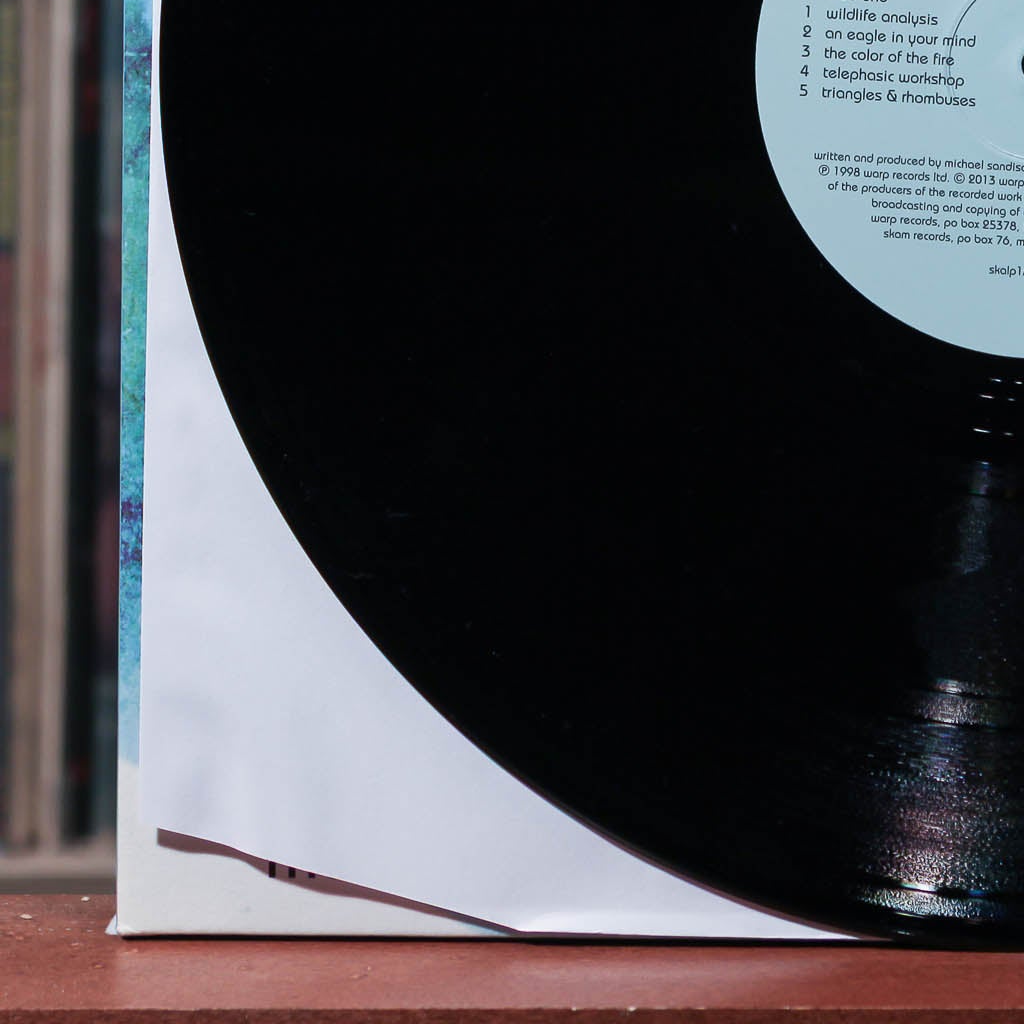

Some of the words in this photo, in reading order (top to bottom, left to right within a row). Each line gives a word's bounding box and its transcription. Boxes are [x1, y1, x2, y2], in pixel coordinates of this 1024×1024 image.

[806, 5, 811, 18] 1
[826, 8, 877, 22] wildlife
[881, 11, 938, 27] analysis
[803, 25, 812, 38] 2
[825, 29, 842, 40] an
[847, 29, 886, 45] eagle
[892, 31, 904, 44] in
[908, 35, 938, 47] your
[942, 35, 976, 48] mind
[801, 45, 811, 57] 3
[824, 47, 847, 60] the
[851, 49, 884, 62] color
[888, 50, 903, 63] of
[906, 51, 929, 65] the
[933, 53, 955, 66] fire
[800, 65, 809, 77] 4
[823, 67, 895, 83] telephasic
[898, 72, 965, 89] workshop
[799, 84, 808, 97] 5
[822, 86, 882, 104] triangles
[886, 89, 897, 102] &
[901, 90, 976, 107] rhombuses
[814, 151, 850, 162] written
[853, 154, 874, 164] and
[876, 156, 925, 167] produced
[928, 157, 941, 170] by
[944, 159, 984, 170] michael
[834, 166, 861, 177] 1998
[863, 169, 890, 180] warp
[892, 171, 931, 182] records
[933, 172, 950, 183] ltd.
[968, 174, 996, 185] 2013
[999, 177, 1024, 189] warp
[827, 181, 839, 191] of
[841, 182, 859, 192] the
[861, 185, 912, 196] producers
[915, 186, 926, 196] of
[928, 187, 946, 198] the
[949, 190, 995, 200] recorded
[997, 192, 1022, 202] work
[871, 198, 940, 214] broadcasting
[942, 203, 963, 213] and
[965, 205, 1007, 218] copying
[1009, 206, 1021, 217] of
[870, 215, 897, 226] warp
[900, 216, 941, 228] records,
[943, 219, 958, 229] po
[961, 218, 980, 229] box
[982, 220, 1020, 233] 25378,
[883, 229, 911, 240] skam
[913, 232, 954, 244] records,
[957, 235, 971, 245] po
[974, 234, 993, 245] box
[996, 235, 1013, 248] 76,
